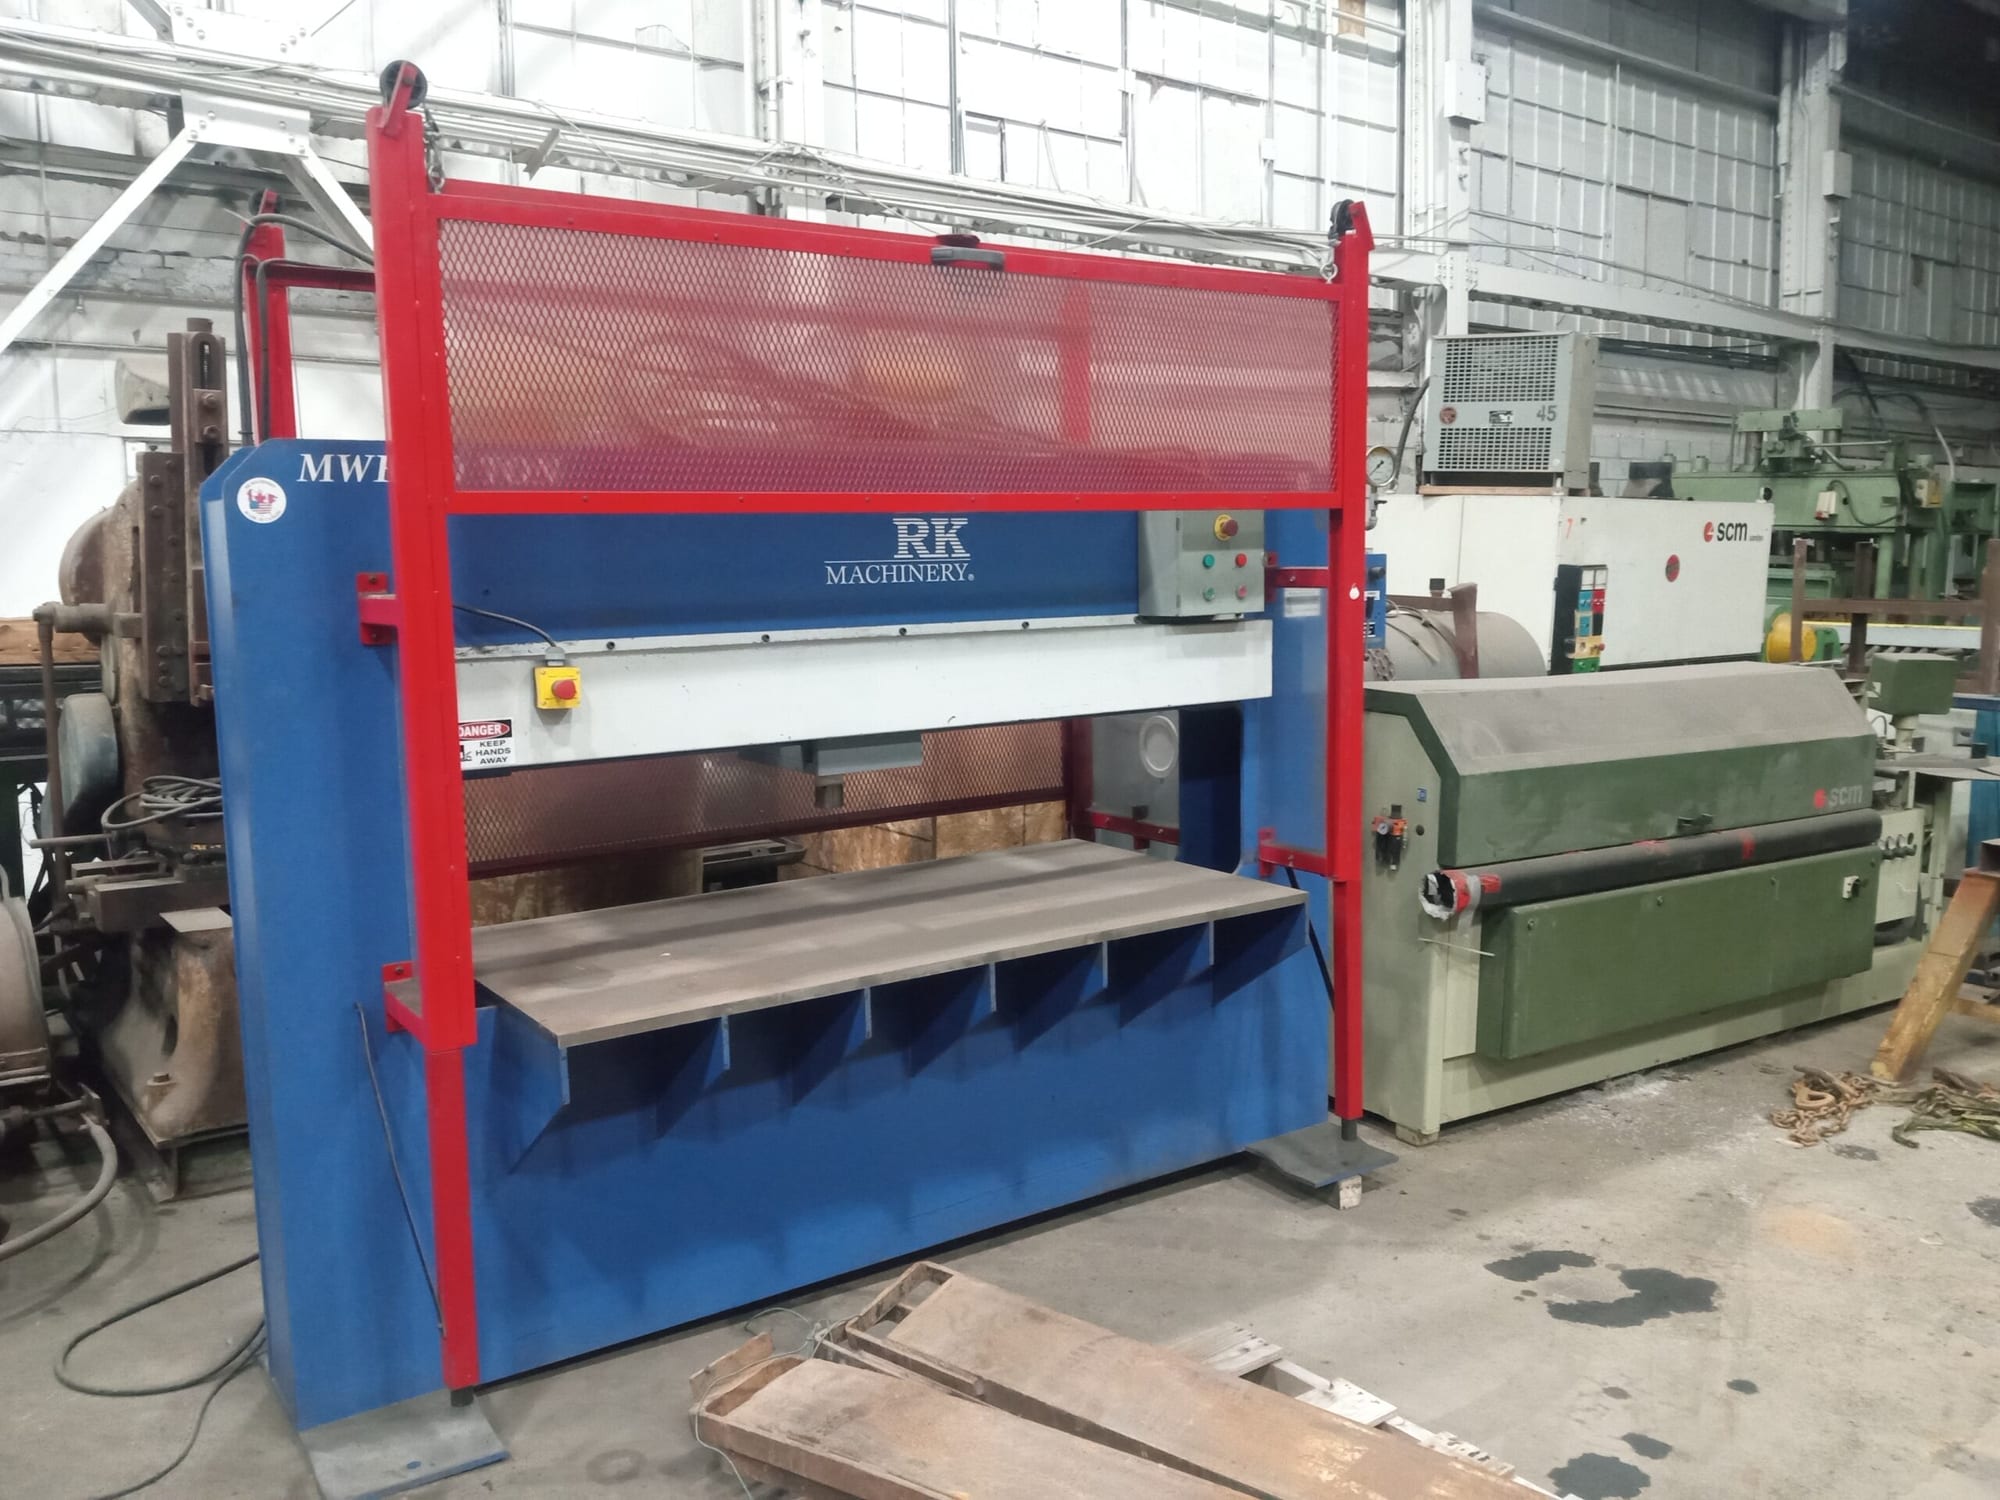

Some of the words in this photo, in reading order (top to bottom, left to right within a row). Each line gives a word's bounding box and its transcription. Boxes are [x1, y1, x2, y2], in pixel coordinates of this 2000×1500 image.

[1536, 404, 1557, 422] 45
[892, 517, 971, 559] RK
[1716, 521, 1748, 542] scm
[475, 747, 512, 757] HANDS
[479, 739, 506, 748] KEEP
[480, 756, 508, 765] AWAY
[1829, 784, 1864, 807] scm
